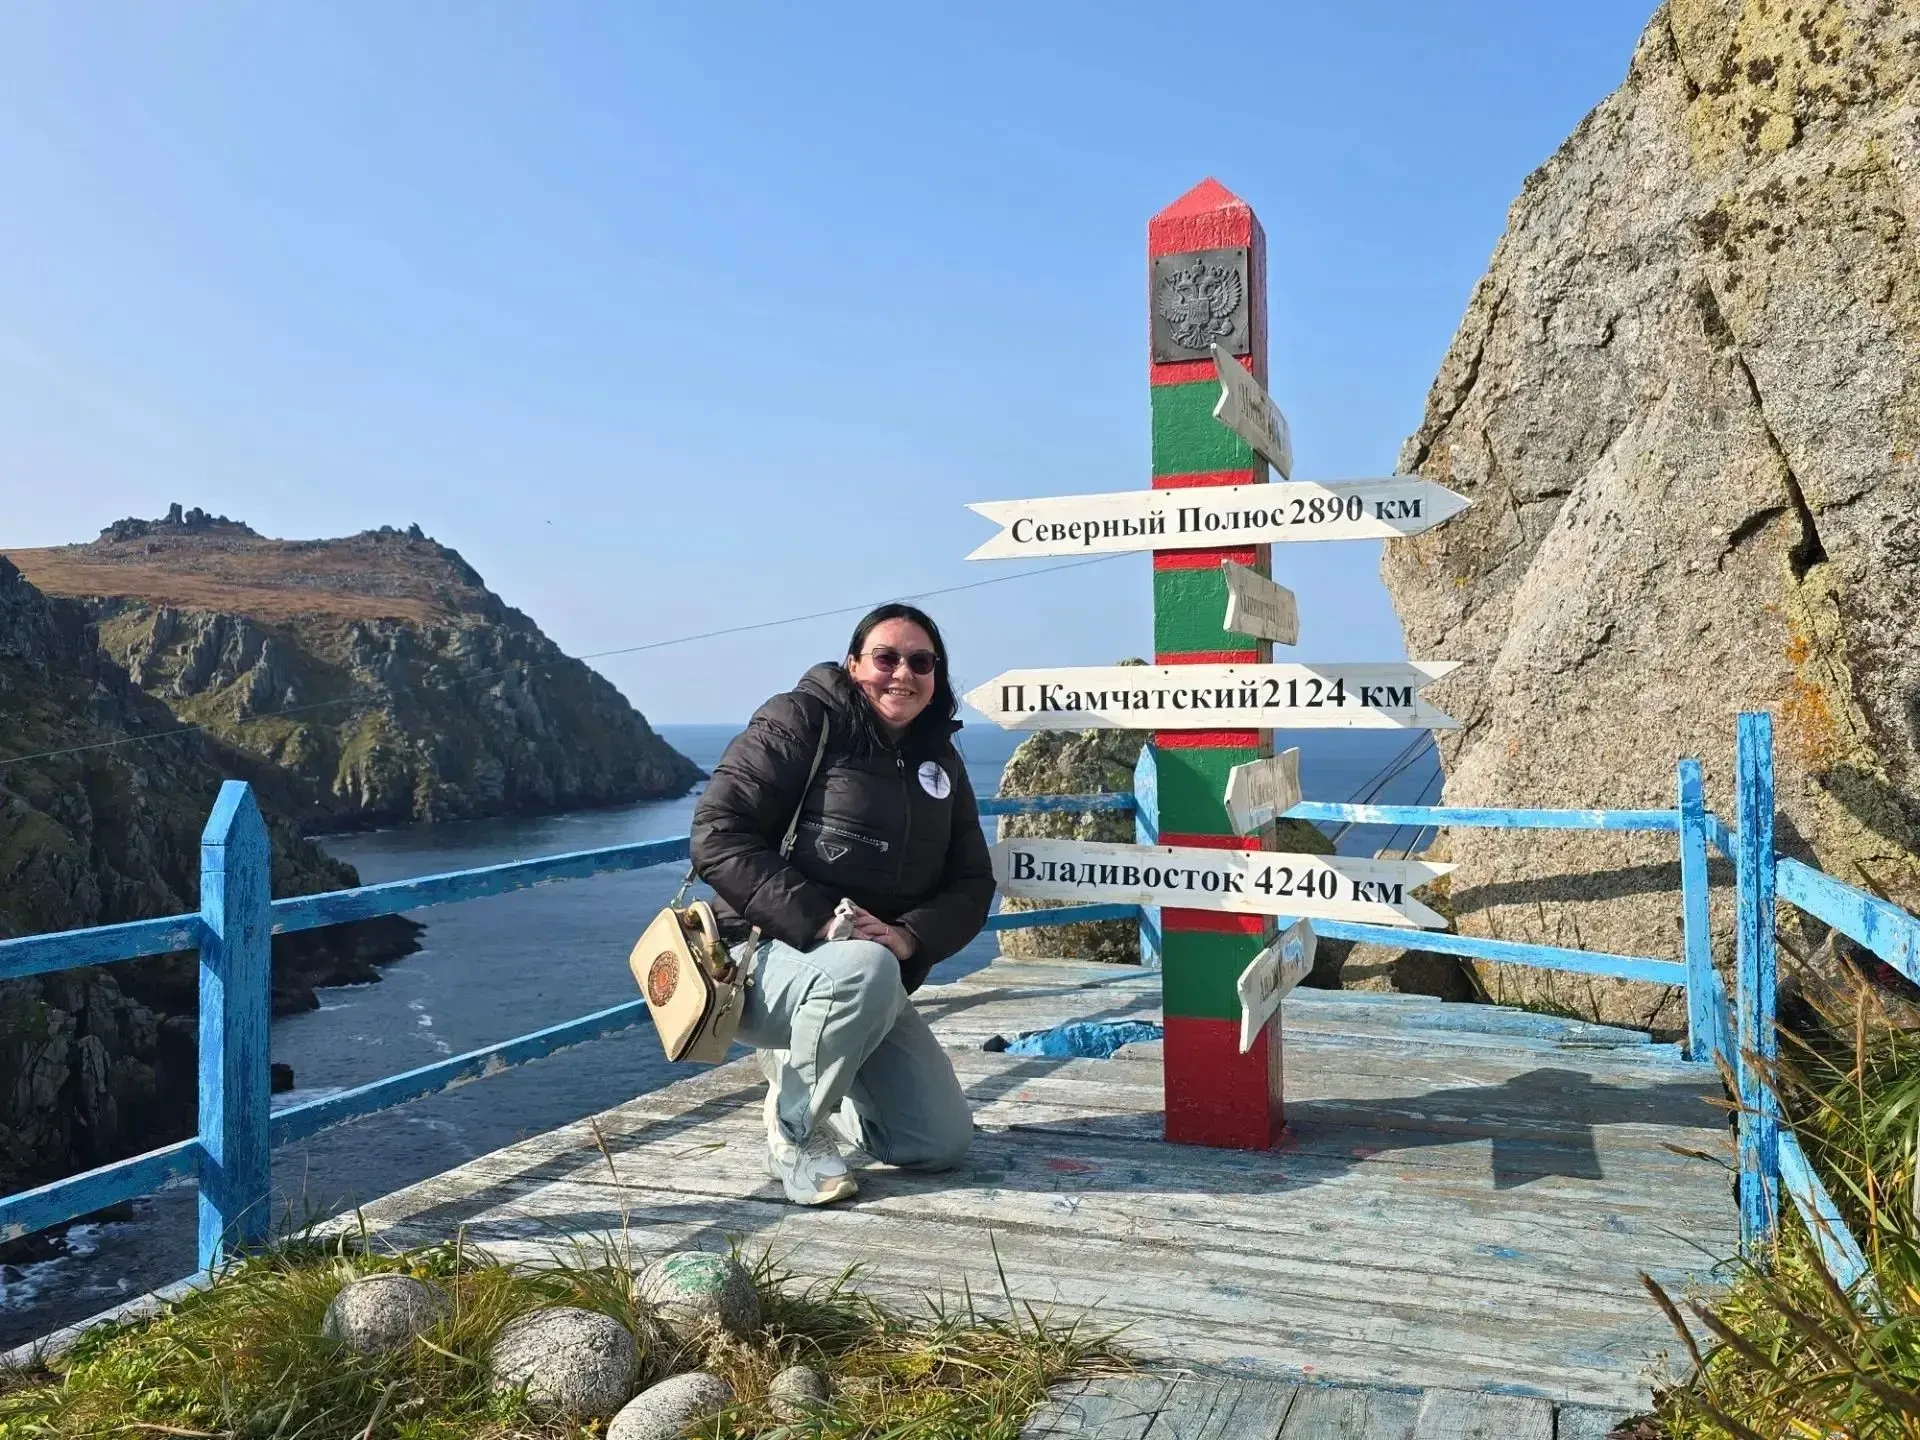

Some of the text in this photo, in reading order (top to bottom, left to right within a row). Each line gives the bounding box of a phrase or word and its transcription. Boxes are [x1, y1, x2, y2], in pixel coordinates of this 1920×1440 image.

[1010, 494, 1422, 546] Северный Полюс 2890 км
[1360, 686, 1413, 708] км
[1011, 850, 1404, 906] Владивосток 4240 км
